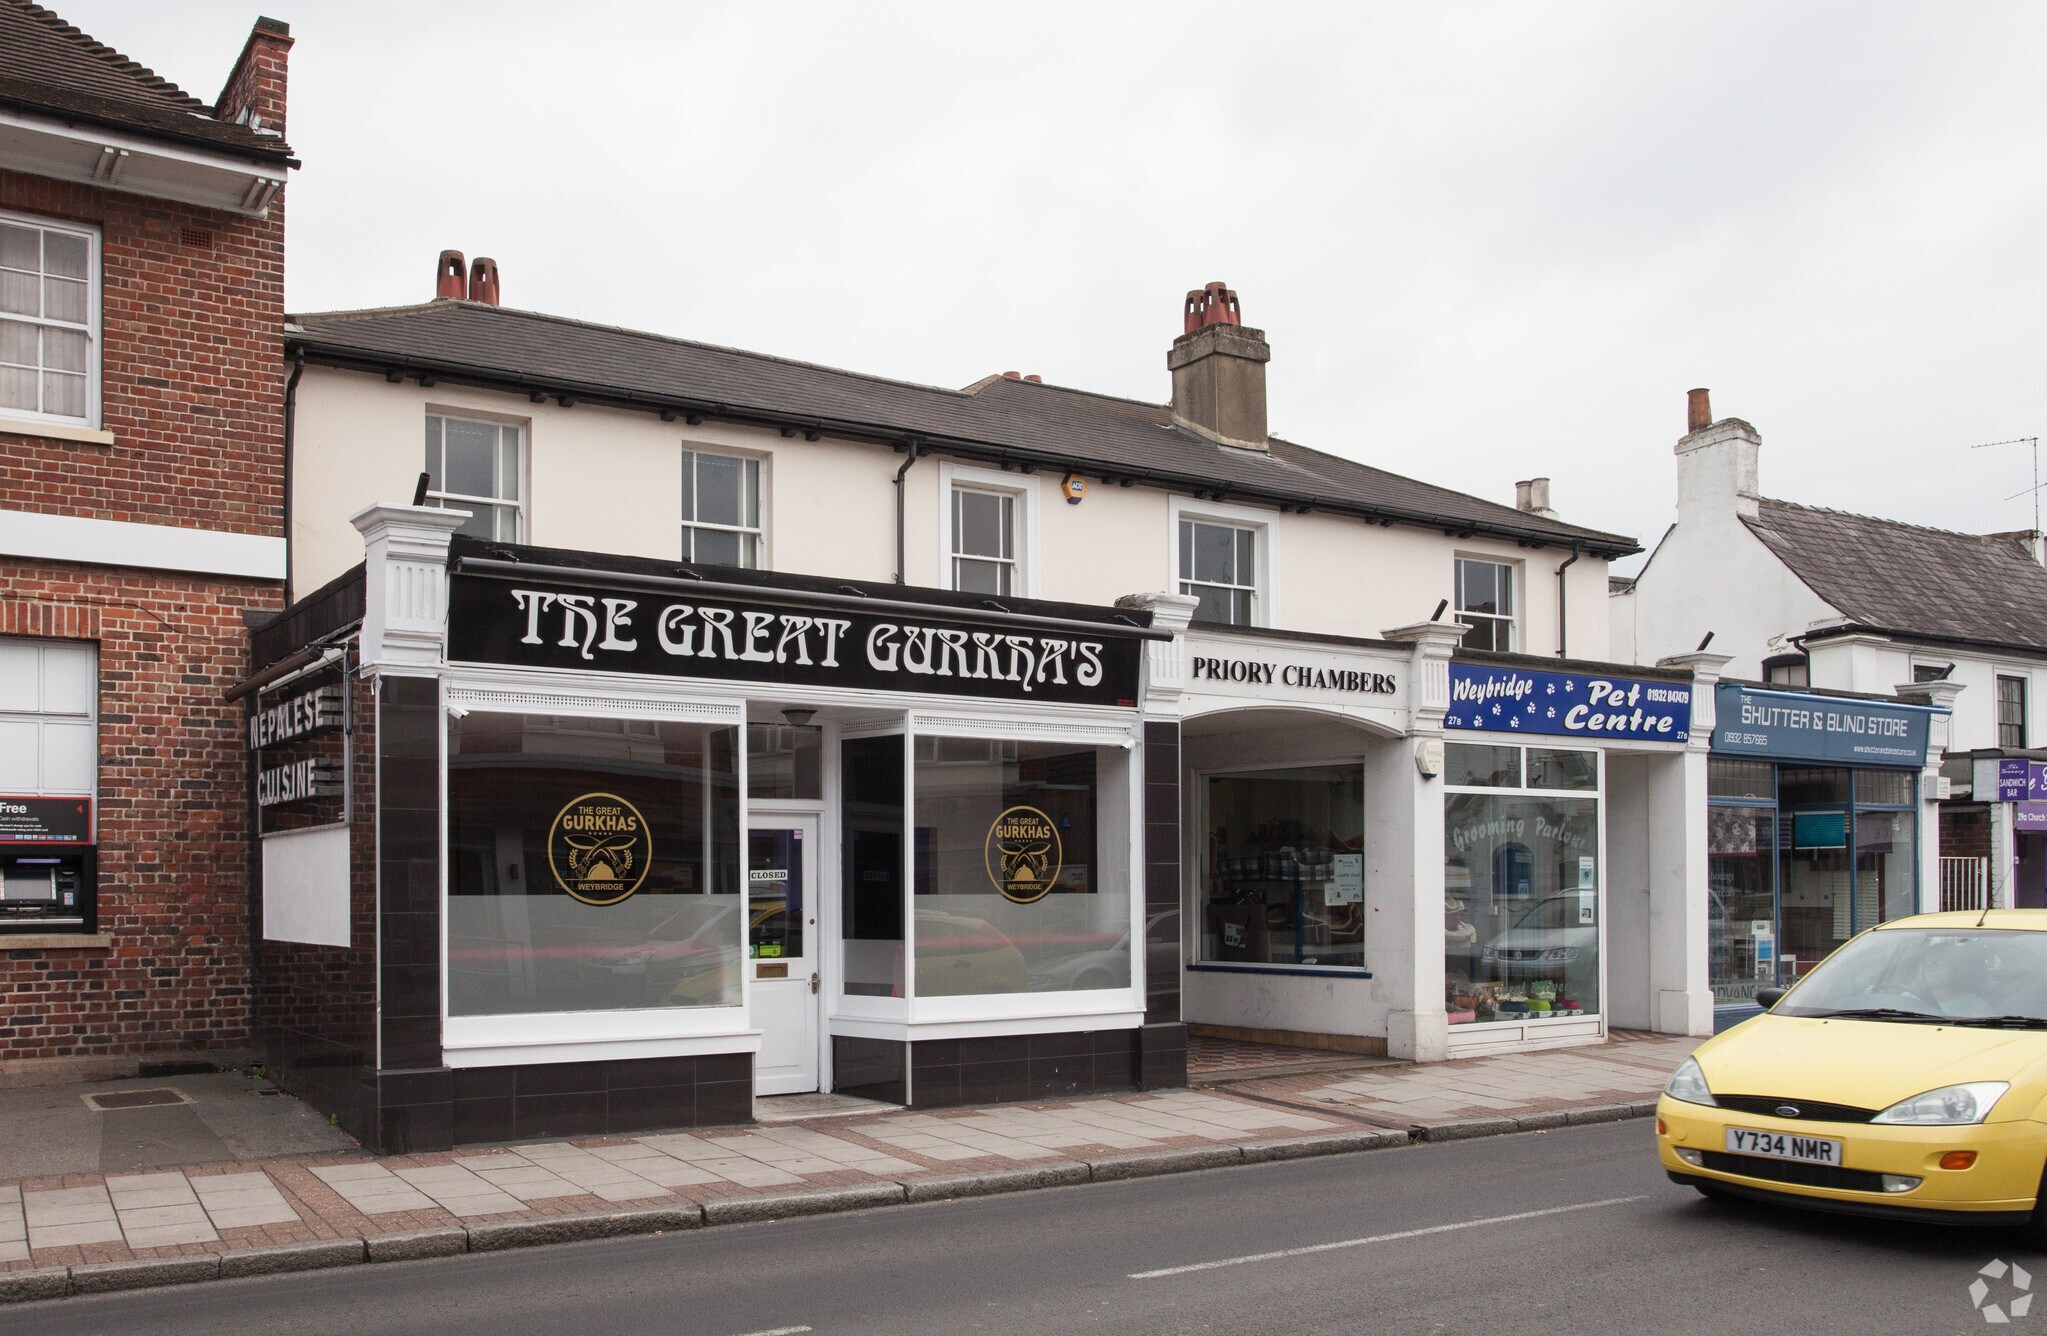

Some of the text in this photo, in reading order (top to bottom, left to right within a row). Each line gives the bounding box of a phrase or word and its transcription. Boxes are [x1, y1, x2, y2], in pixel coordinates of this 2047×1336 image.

[511, 589, 1103, 692] THE GREAT GURKHA'S
[1192, 656, 1396, 695] PRIORY CHAMBERS
[1452, 673, 1533, 705] Weybridge
[1587, 680, 1641, 707] Pet
[1647, 688, 1667, 703] 01932
[1740, 695, 1752, 705] THE
[251, 687, 324, 750] NEPALESE
[1564, 704, 1673, 733] Centre
[1741, 705, 1908, 737] SHUTTER & BLIND STORE
[257, 758, 316, 806] CUISINE
[2000, 778, 2026, 787] SANDWICH
[2007, 788, 2018, 797] BAR
[0, 802, 27, 814] Free
[578, 806, 622, 816] THE GREAT
[563, 815, 637, 831] GURKHAS
[1007, 817, 1019, 825] THE
[2028, 813, 2045, 822] Church
[996, 825, 1051, 839] GURKHAS
[1453, 815, 1525, 852] Grooming
[751, 871, 787, 880] CLOSED
[578, 883, 624, 891] WEYBRIDGE
[1734, 1130, 1832, 1161] Y734 NMR
